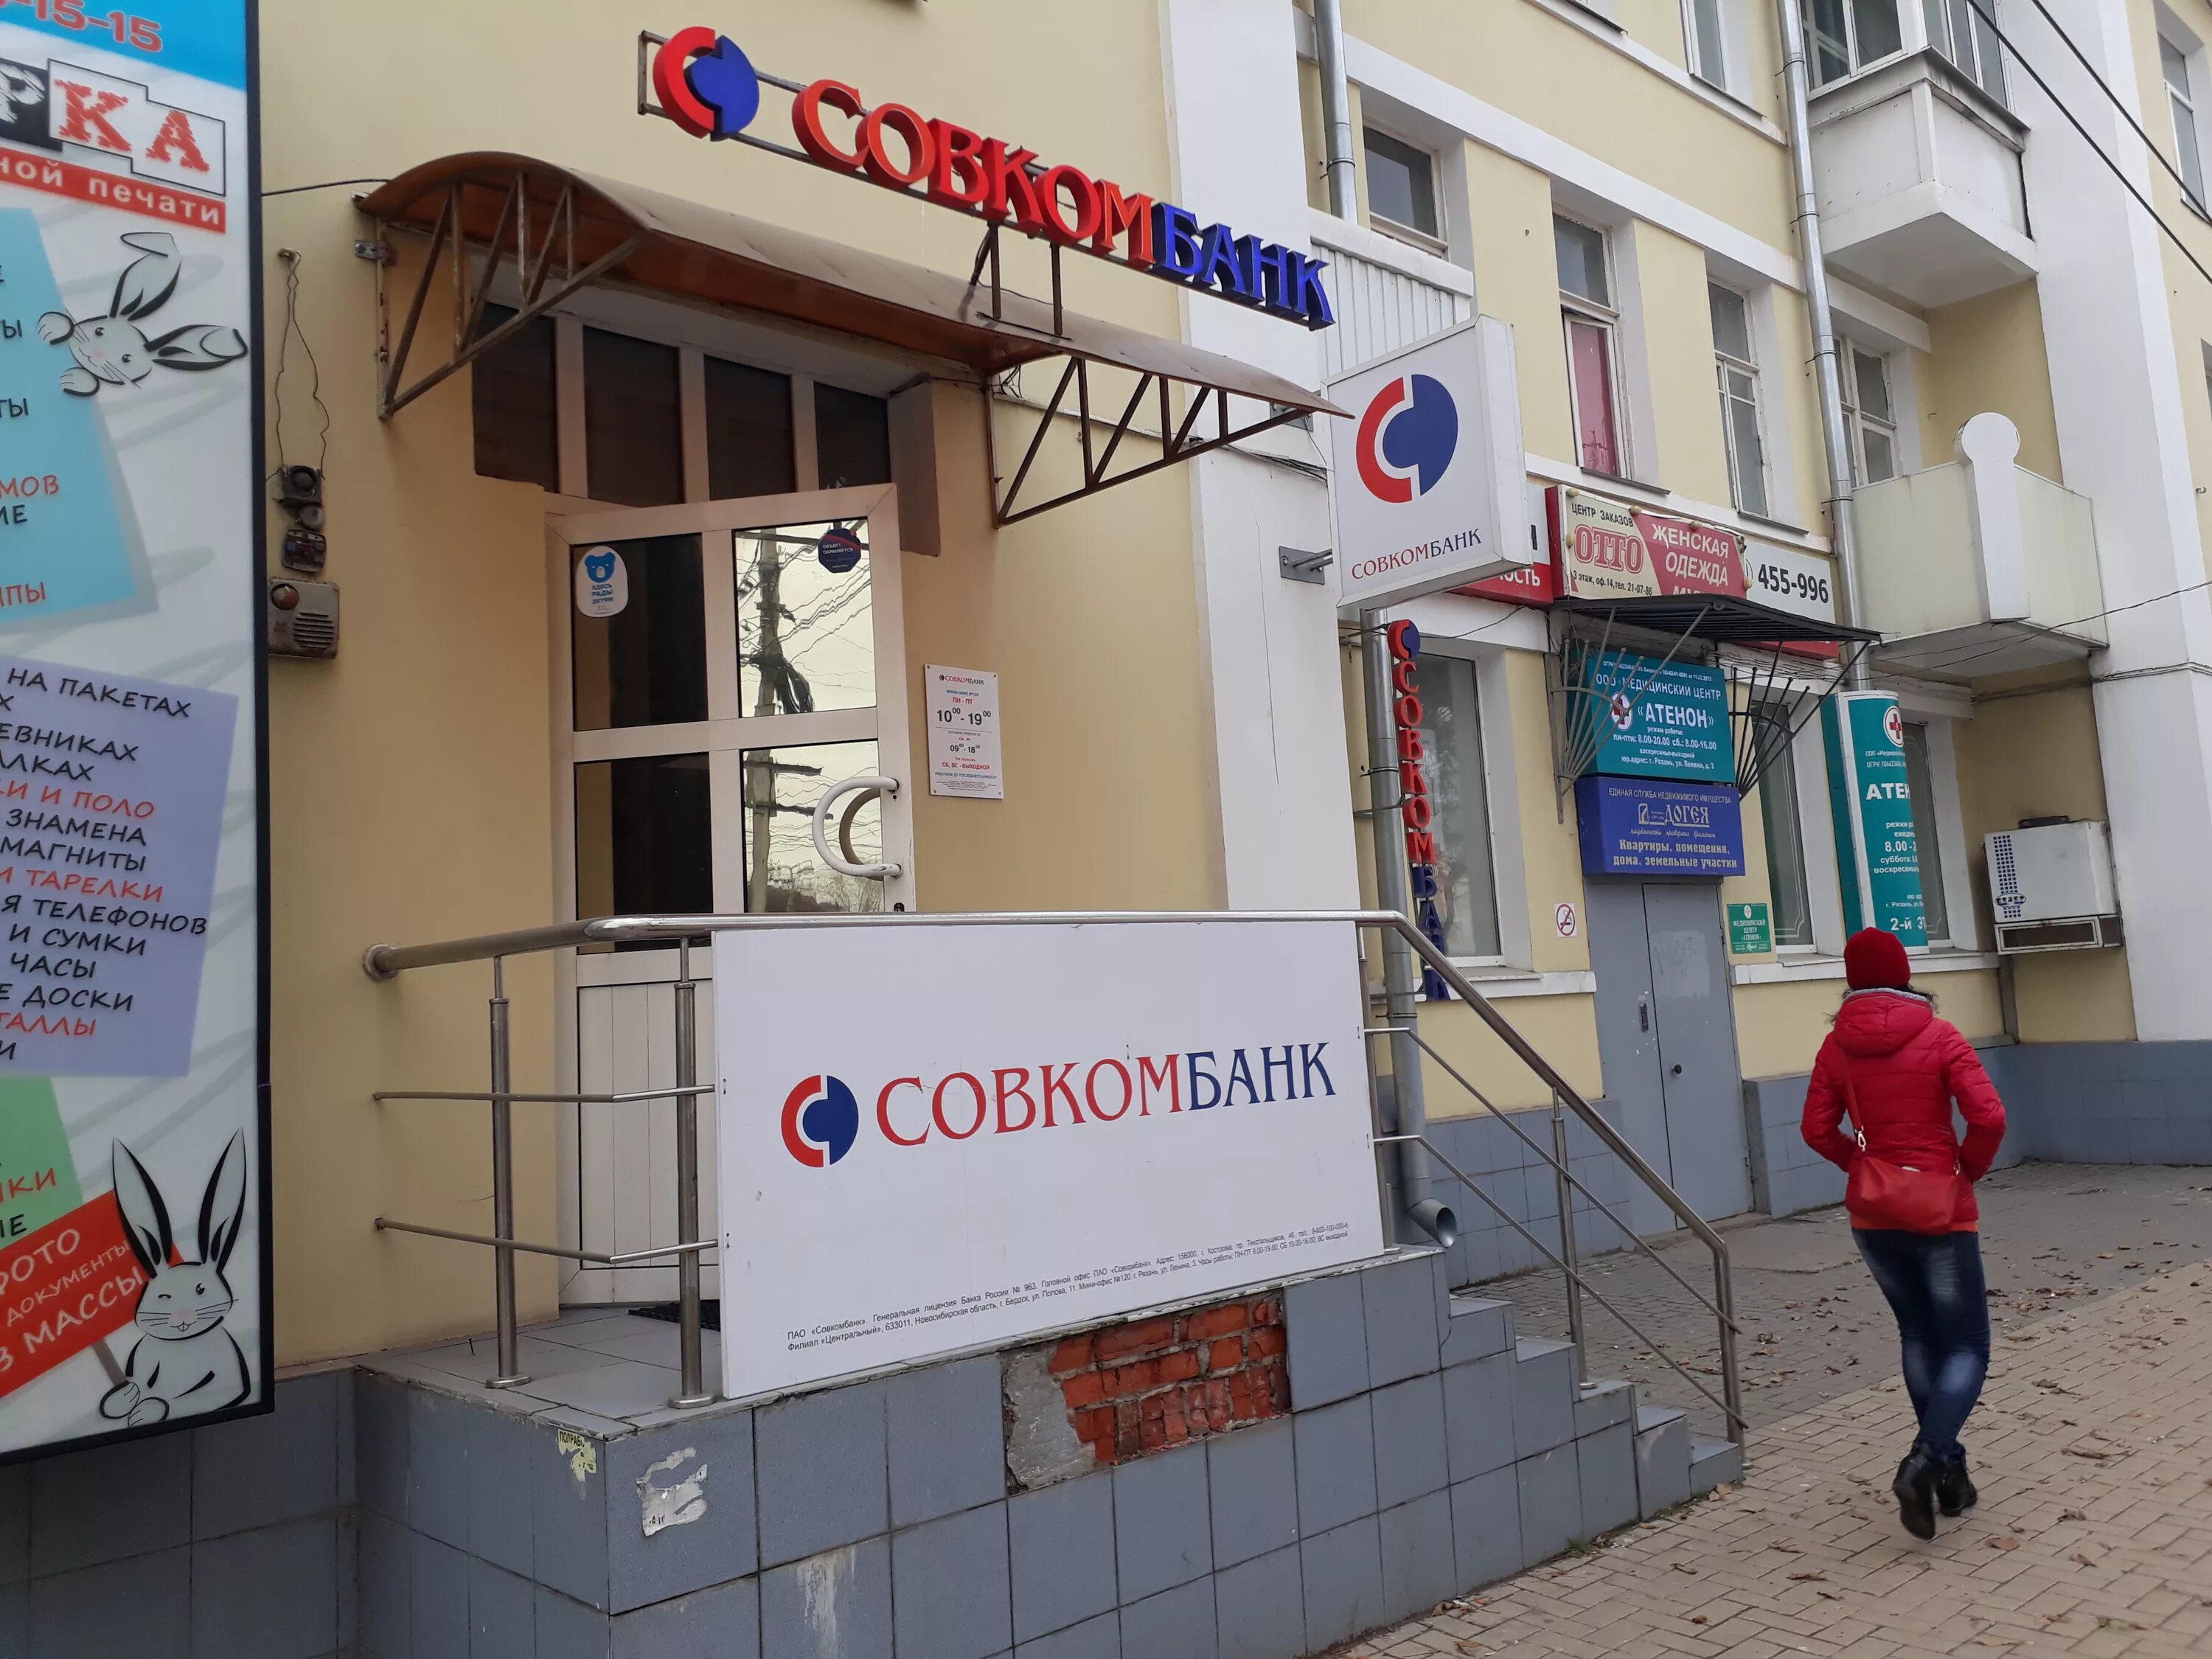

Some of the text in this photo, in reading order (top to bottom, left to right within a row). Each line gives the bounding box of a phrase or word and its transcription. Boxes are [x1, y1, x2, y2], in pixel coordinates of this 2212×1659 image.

[88, 177, 219, 225] печати
[791, 77, 1335, 330] СОВКОМБАНК
[0, 319, 22, 339] Ы
[1571, 503, 1634, 527] ЦЕНТР ЗАКАЗОВ
[1352, 528, 1482, 580] СОВКОМБАНК
[1652, 523, 1729, 559] ЖЕНСКАЯ
[1578, 574, 1595, 585] этаж,
[1627, 582, 1652, 597] 21-07-86
[1666, 552, 1728, 587] ОДЕЖДА
[1758, 563, 1829, 604] 455-996
[0, 581, 46, 607] ПЫ
[7, 667, 191, 718] НА ПАКЕТАХ
[1693, 686, 1721, 700] ЦЕНТР
[1638, 702, 1714, 728] «АТЕНОН»
[0, 723, 139, 762] ЕВНИКАХ
[1638, 734, 1671, 746] 8.00-20.00
[1685, 740, 1717, 751] 8.00-16.00
[0, 779, 155, 819] И И ПОЛО
[1608, 787, 1731, 804] ЕДИНАЯ СЛУЖБА НЕДВИЖИМОГО ИМУЩЕСТВА
[6, 808, 147, 846] ЗНАМЕНА
[1885, 821, 1908, 830] режим
[0, 835, 146, 872] МАГНИТЫ
[1613, 855, 1737, 870] дома, земельные участки
[1618, 839, 1731, 855] Квартиры, помещения,
[26, 869, 163, 903] ТАРЕЛКИ
[33, 898, 207, 936] ТЕЛЕФОНОВ
[1890, 917, 1912, 931] 2-й
[9, 923, 147, 956] И СУМКИ
[10, 951, 95, 979] ЧАСЫ
[22, 985, 133, 1012] ДОСКИ
[876, 1042, 1336, 1147] СОВКОМБАНК
[0, 1167, 56, 1203] КИ
[0, 1213, 27, 1238] Е
[7, 1239, 130, 1327] ДОКУМЕНТЫ
[23, 1265, 144, 1354] МАССЫ
[787, 1329, 806, 1340] ПАО
[811, 1319, 868, 1335] «Совкомбанк».
[873, 1307, 919, 1322] Генеральная
[924, 1299, 957, 1312] лицензия
[961, 1295, 981, 1304] Банка
[985, 1289, 1009, 1300] России
[1012, 1285, 1020, 1294] №
[1024, 1282, 1037, 1291] 963.
[1041, 1276, 1071, 1288] Головной
[1074, 1273, 1091, 1282] офис
[1093, 1267, 1107, 1277] ПАО
[787, 1338, 819, 1352] Филиал
[821, 1326, 883, 1344] «Центральный»,
[885, 1318, 914, 1331] 633011,
[914, 1307, 969, 1325] Новосибирская
[970, 1301, 998, 1314] область,
[1005, 1295, 1030, 1307] Бердск,
[1042, 1287, 1068, 1298] Попова,
[1079, 1277, 1113, 1290] Мини-офис
